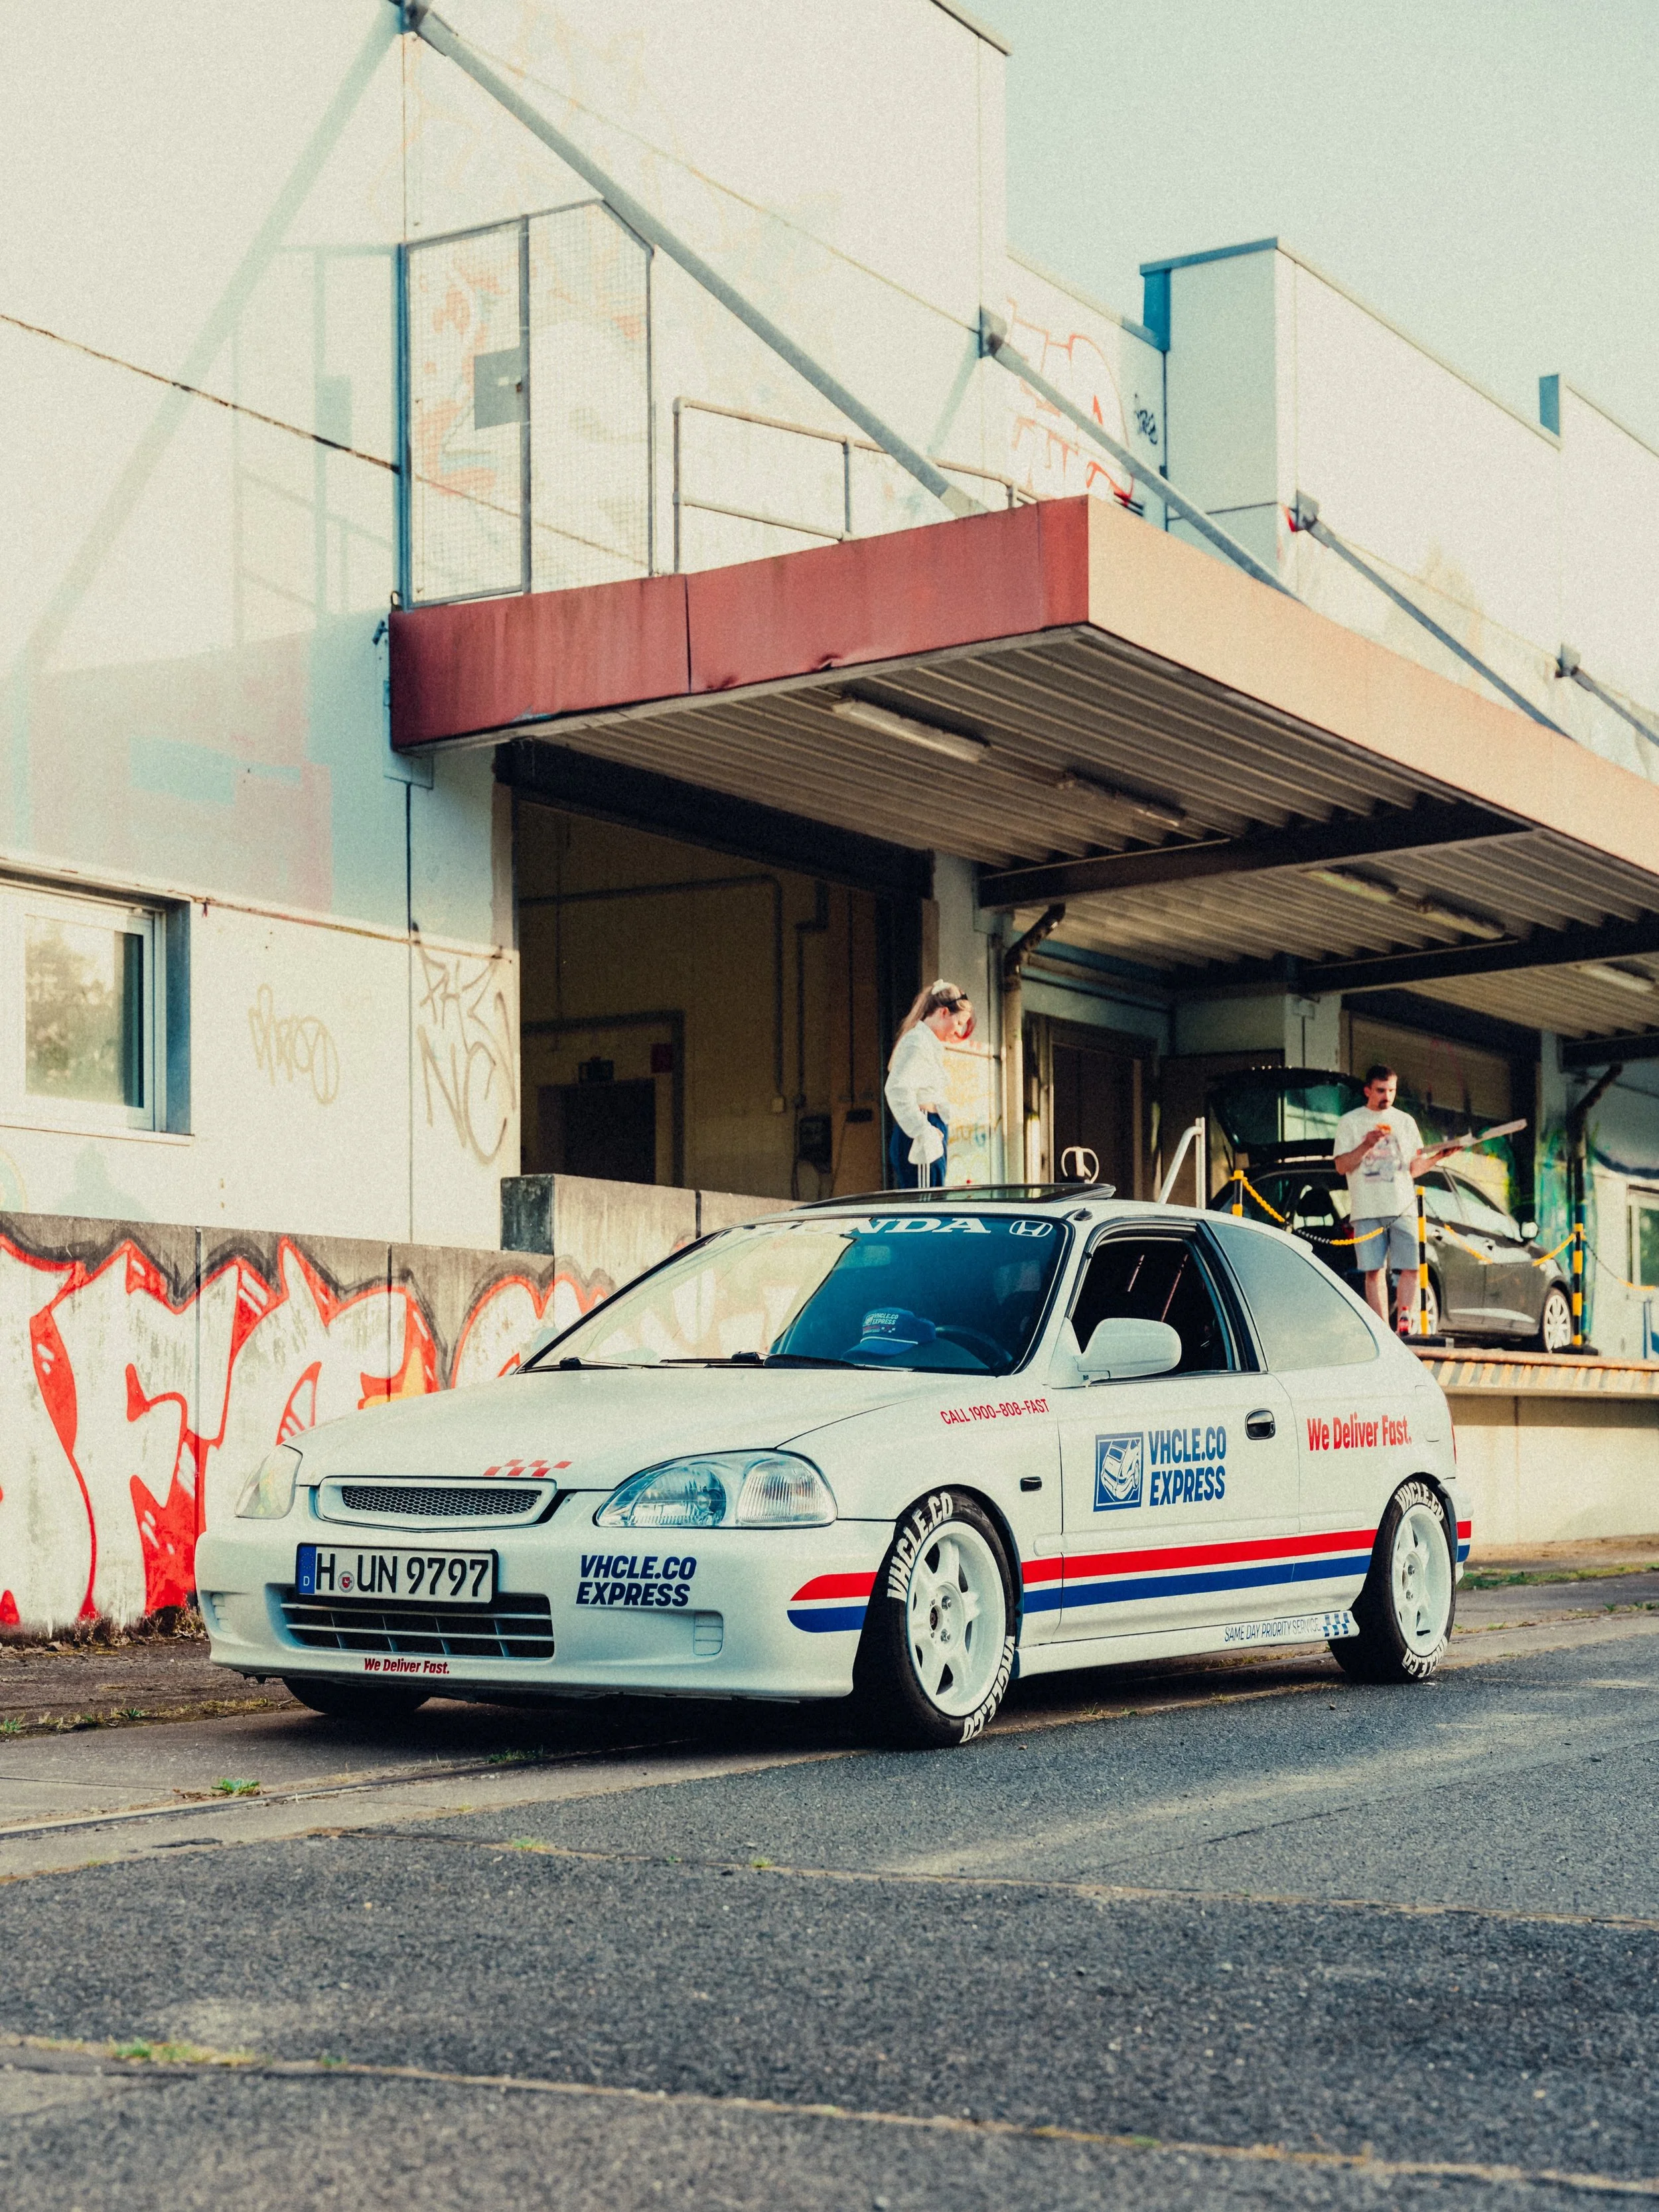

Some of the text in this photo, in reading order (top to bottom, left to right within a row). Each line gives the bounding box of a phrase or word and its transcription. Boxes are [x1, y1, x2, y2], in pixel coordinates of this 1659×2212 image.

[940, 1398, 1050, 1425] CALL 1900-808-FAST
[1306, 1411, 1413, 1451] We Deliver Fast.
[1147, 1425, 1227, 1466] VHCLE.CO
[1149, 1465, 1226, 1507] EXPRESS
[1394, 1481, 1445, 1522] VHCLE.CO
[887, 1491, 954, 1603] VHCLE.CO
[315, 1552, 336, 1591] H
[356, 1554, 398, 1593] UN
[406, 1556, 490, 1597] 9797
[580, 1554, 697, 1581] VHCLE.CO
[575, 1581, 691, 1607] EXPRESS
[1224, 1617, 1321, 1643] SAME DAY PRIORITY SERVICE
[364, 1657, 450, 1674] We Deliver Fast.
[959, 1635, 1016, 1744] VHCLE.CO
